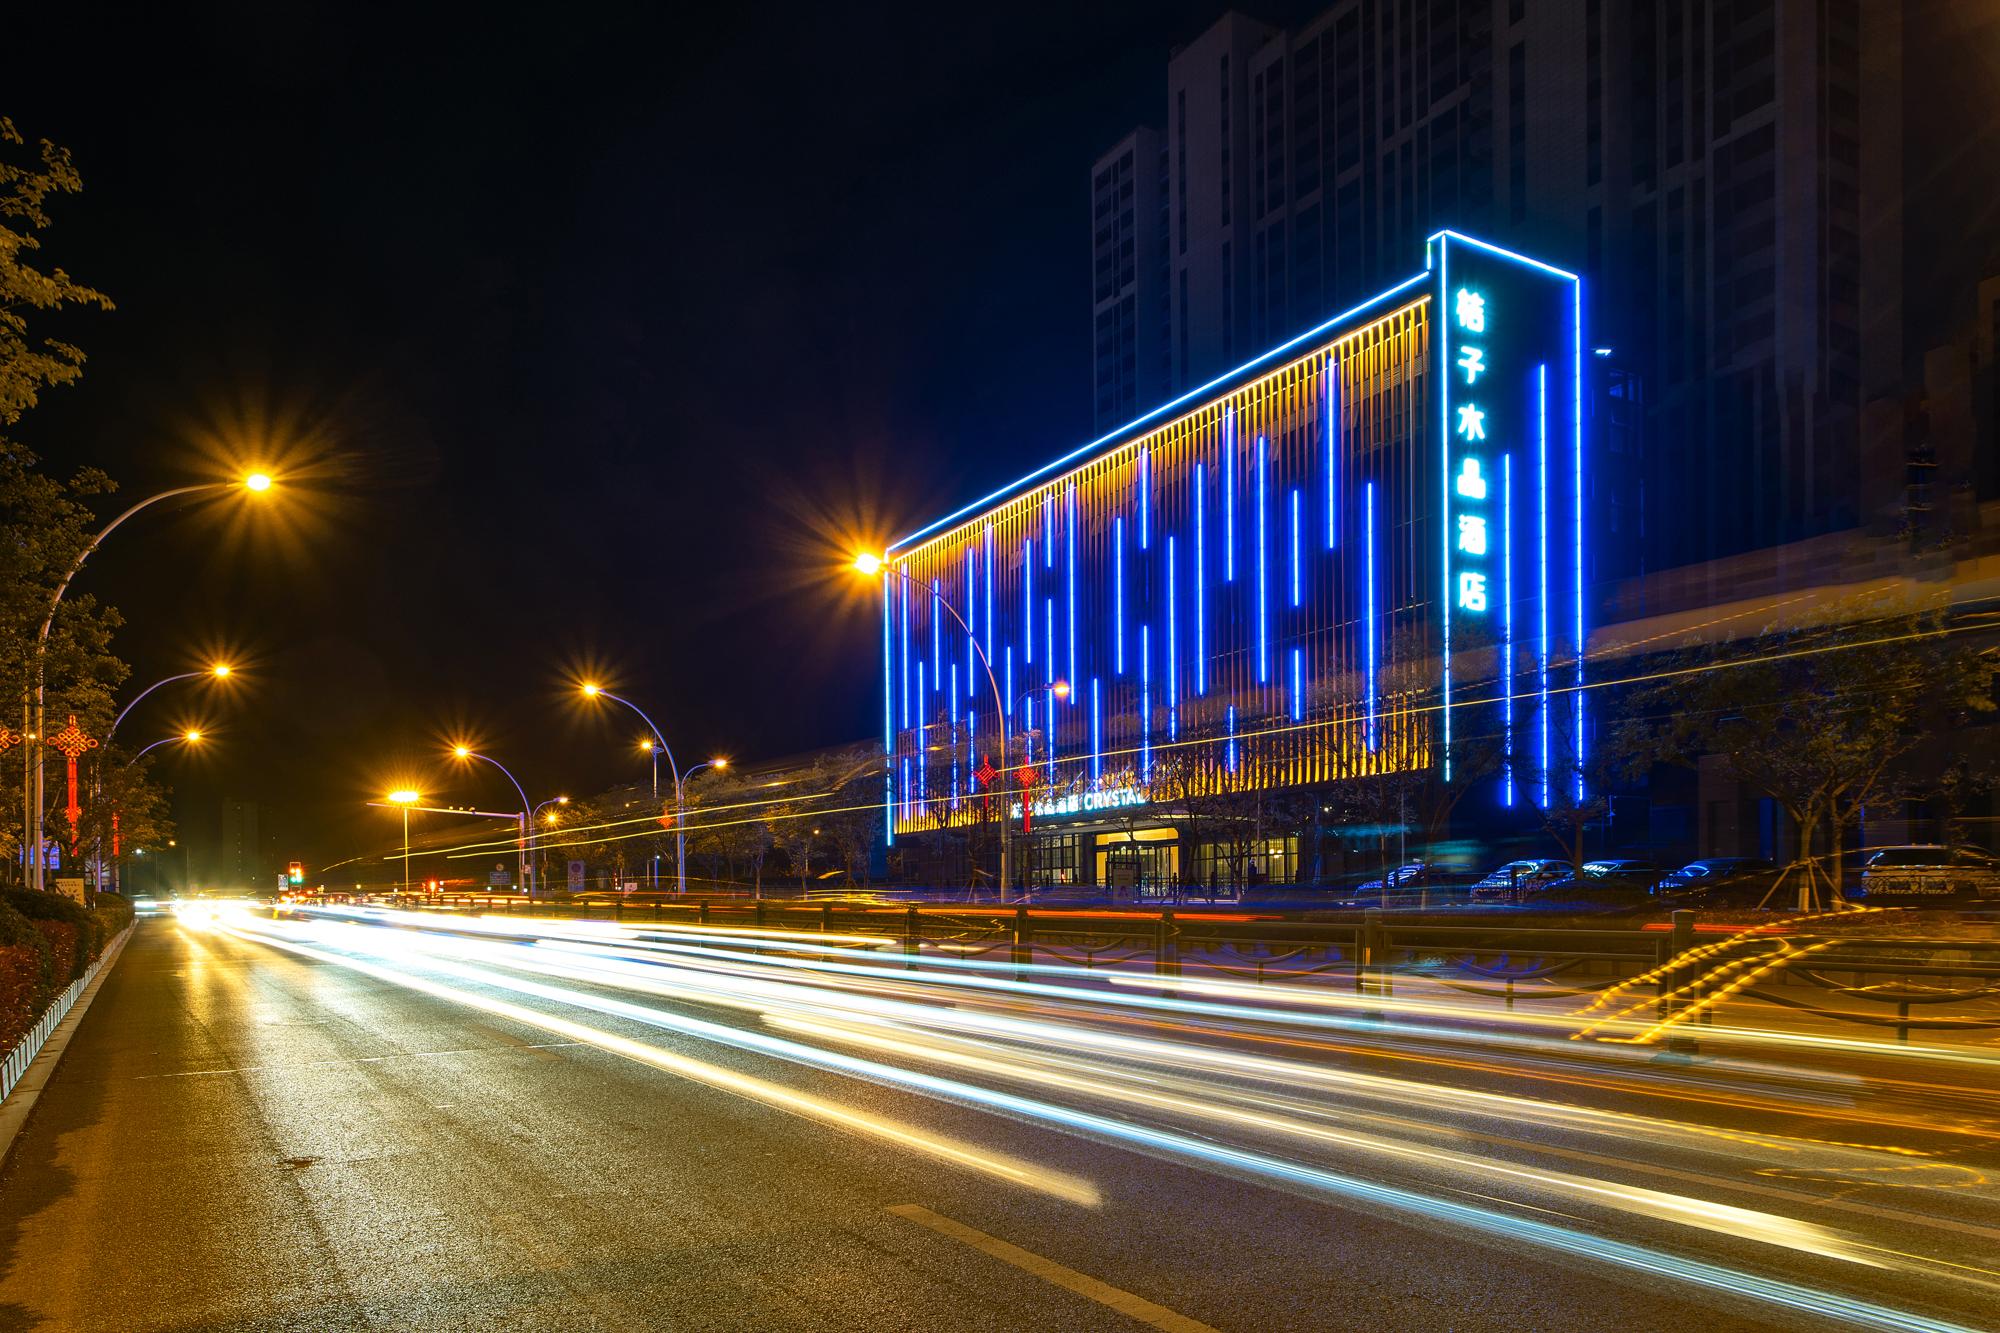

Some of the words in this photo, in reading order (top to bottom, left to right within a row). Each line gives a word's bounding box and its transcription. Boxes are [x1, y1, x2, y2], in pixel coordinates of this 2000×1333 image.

[1456, 287, 1487, 611] 桔子水晶酒店
[1084, 787, 1146, 810] CRYSTAL
